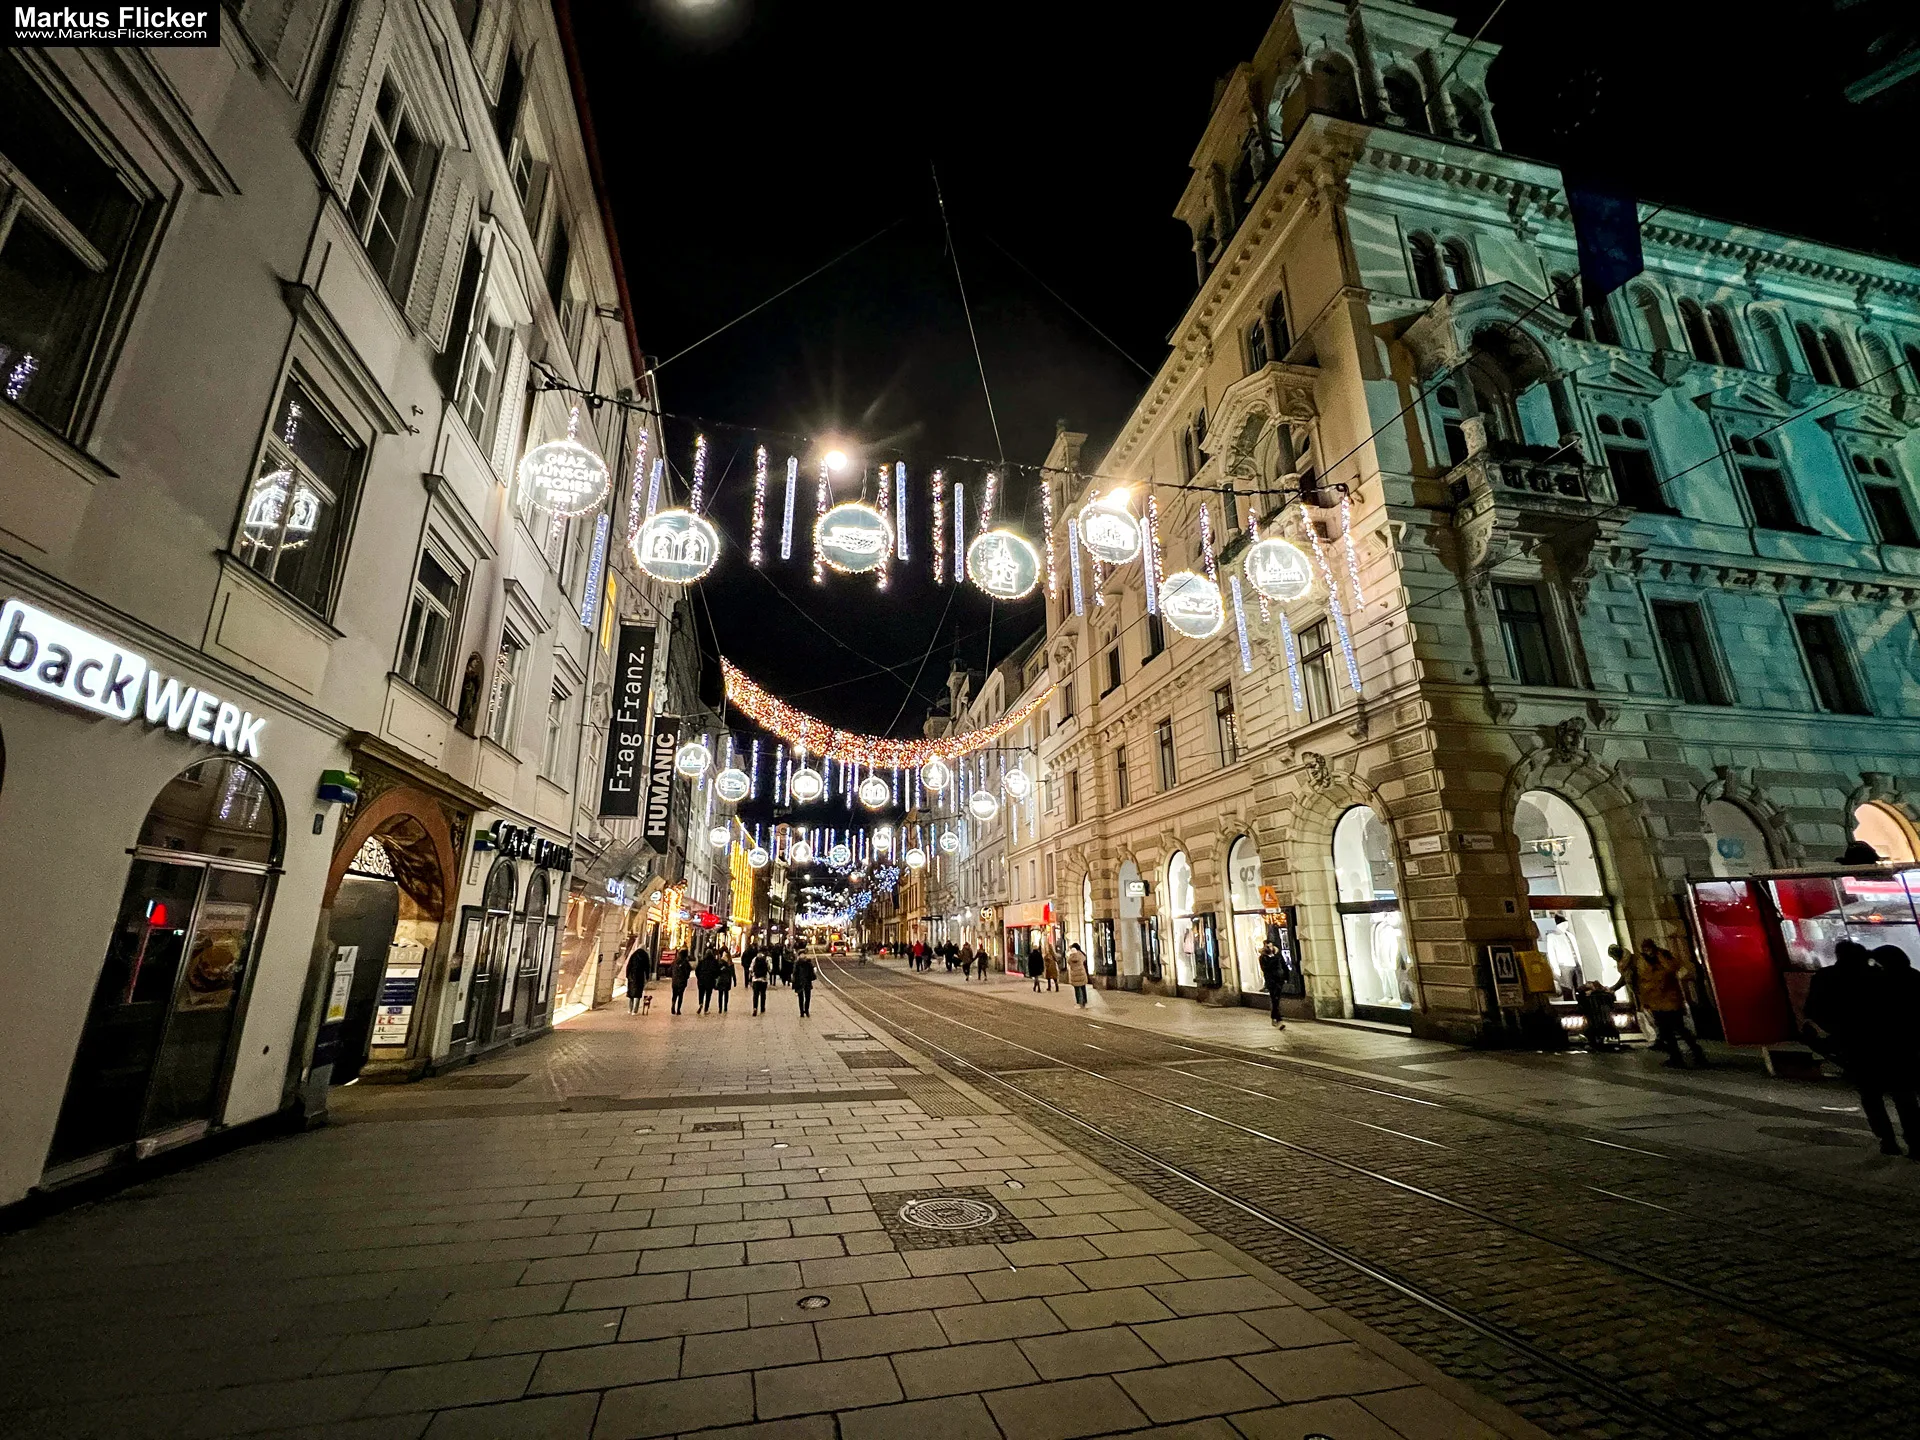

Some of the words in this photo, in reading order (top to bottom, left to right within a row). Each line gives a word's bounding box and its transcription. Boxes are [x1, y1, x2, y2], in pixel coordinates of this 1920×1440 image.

[545, 453, 587, 469] GRAZ
[616, 645, 645, 724] Franz.
[608, 733, 642, 793] Frag
[647, 733, 675, 836] HUMANIC
